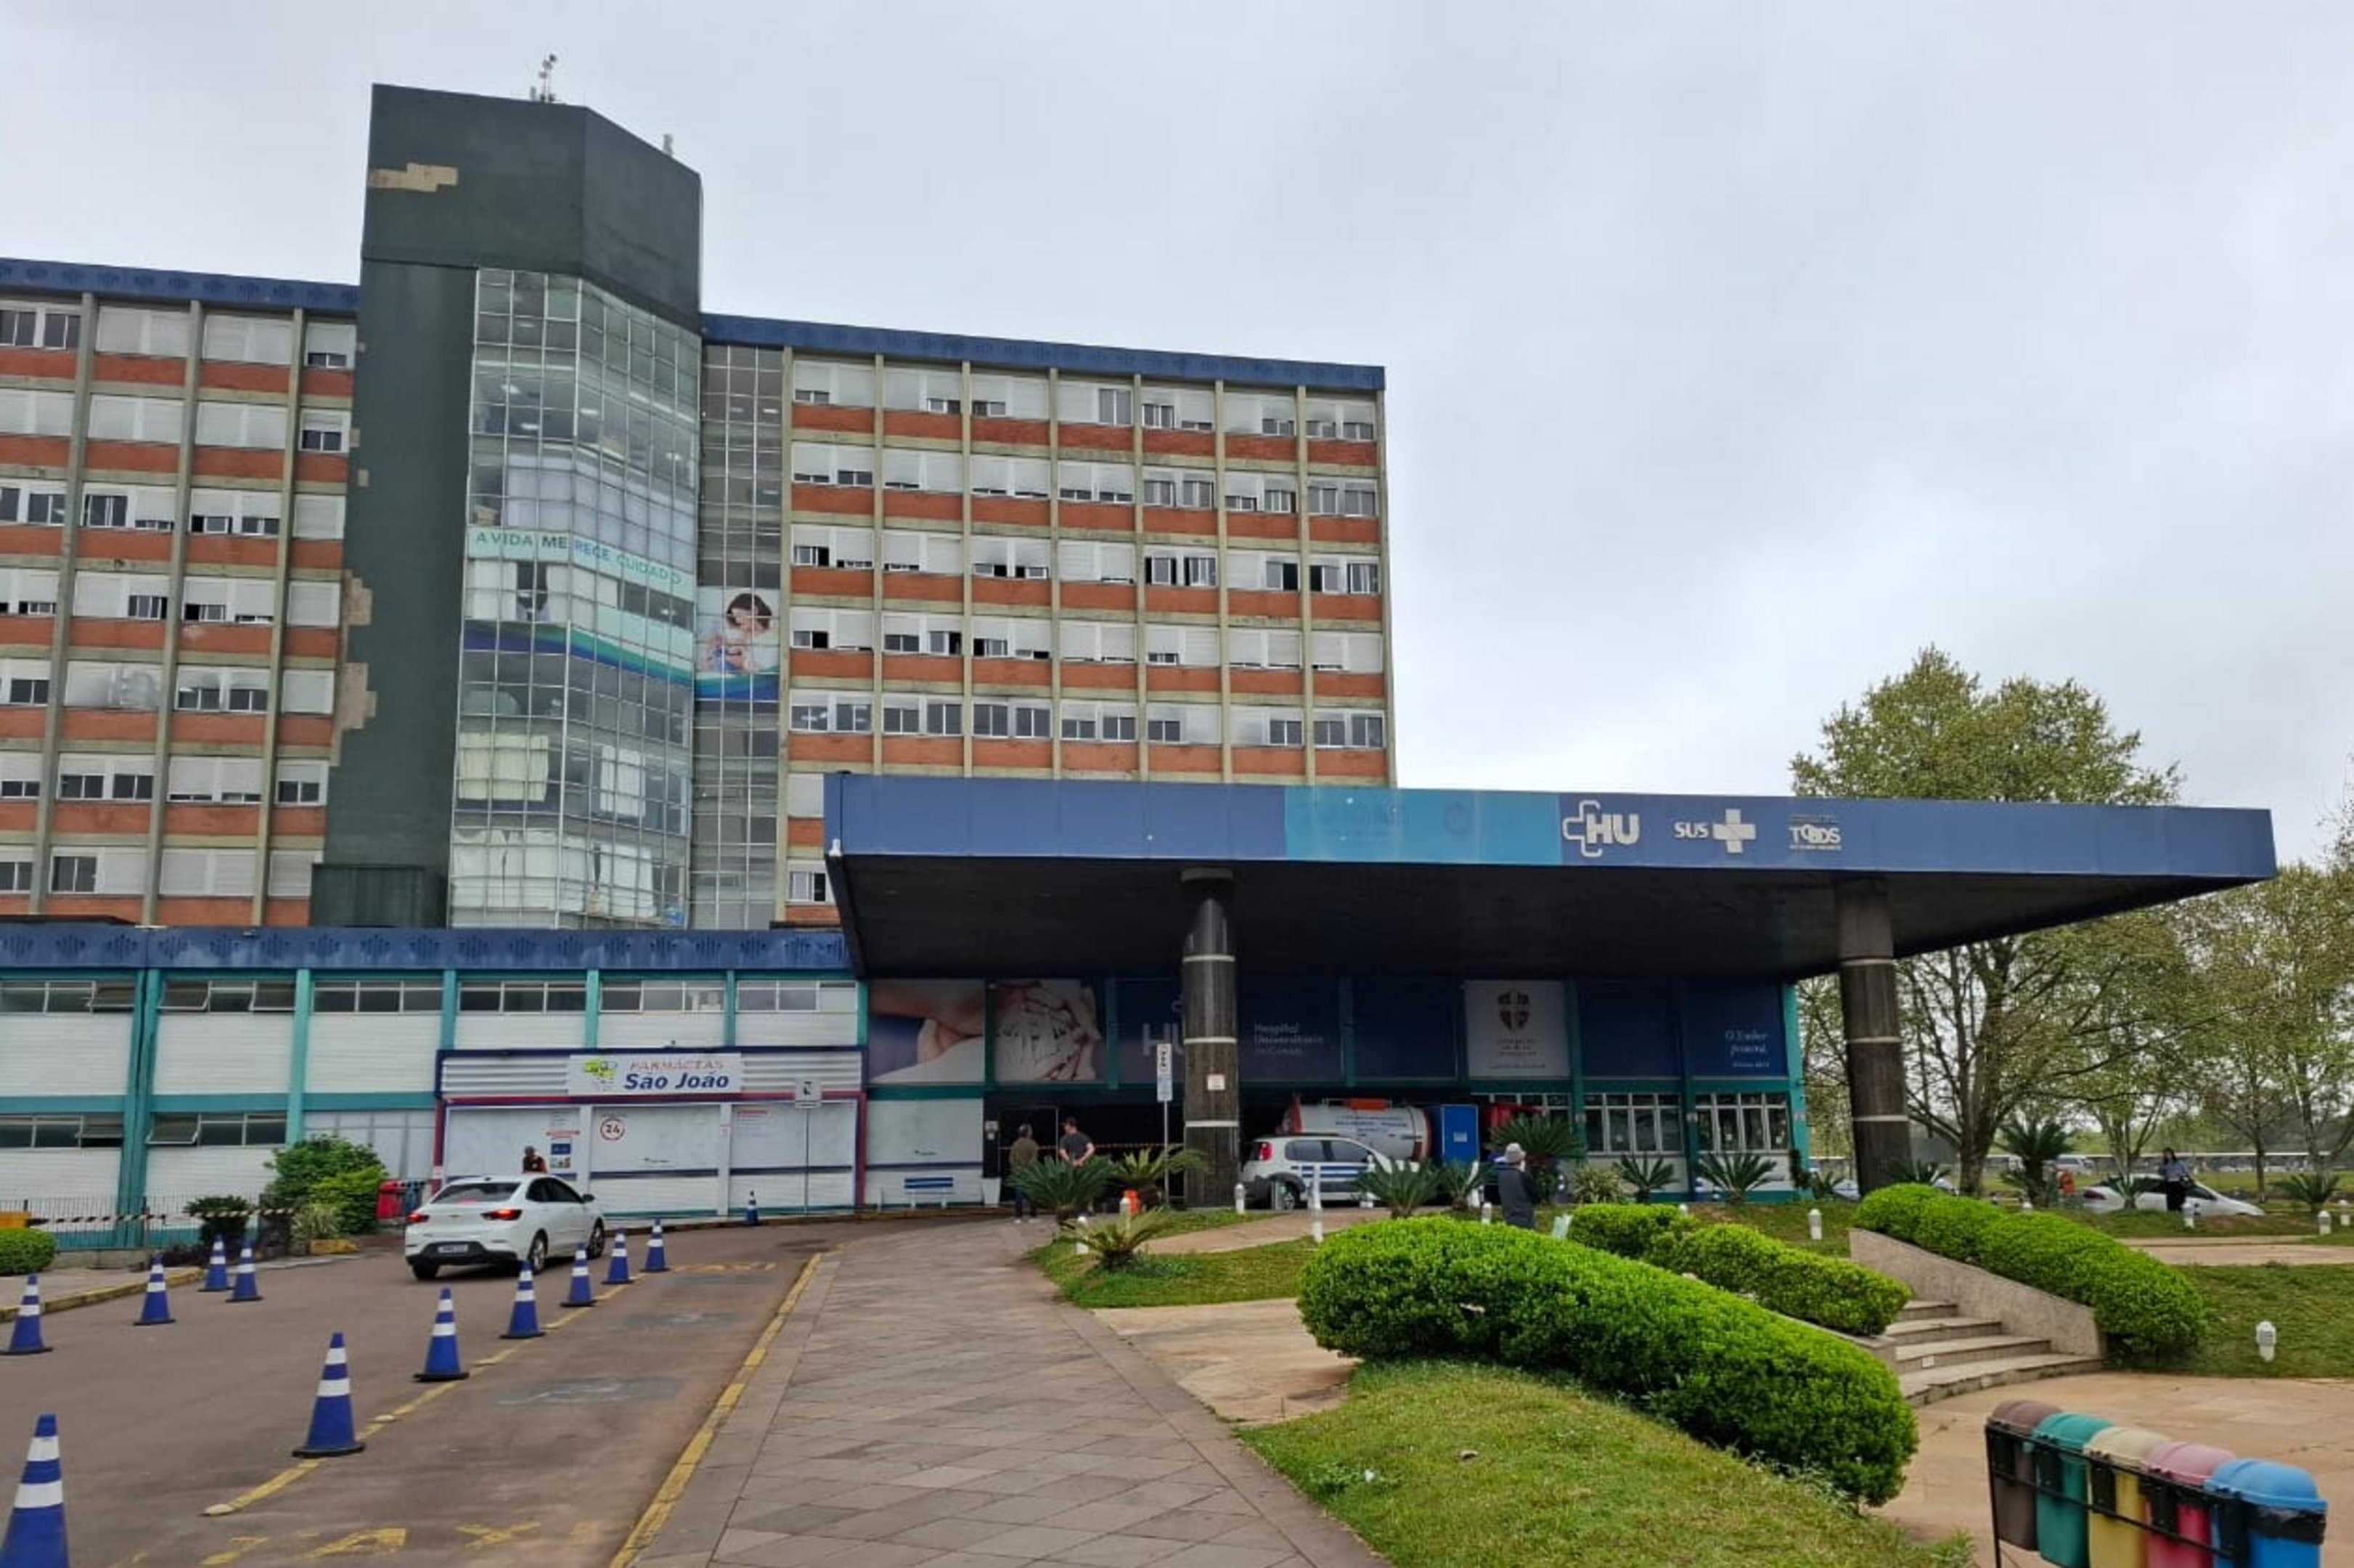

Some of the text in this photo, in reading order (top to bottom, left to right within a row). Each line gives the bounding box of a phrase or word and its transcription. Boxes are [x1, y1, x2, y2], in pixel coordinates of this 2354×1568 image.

[617, 553, 682, 585] CUIDADO
[1585, 812, 1640, 845] HU
[1674, 821, 1709, 839] SUS
[624, 1070, 730, 1090] São João
[605, 1124, 621, 1134] 24
